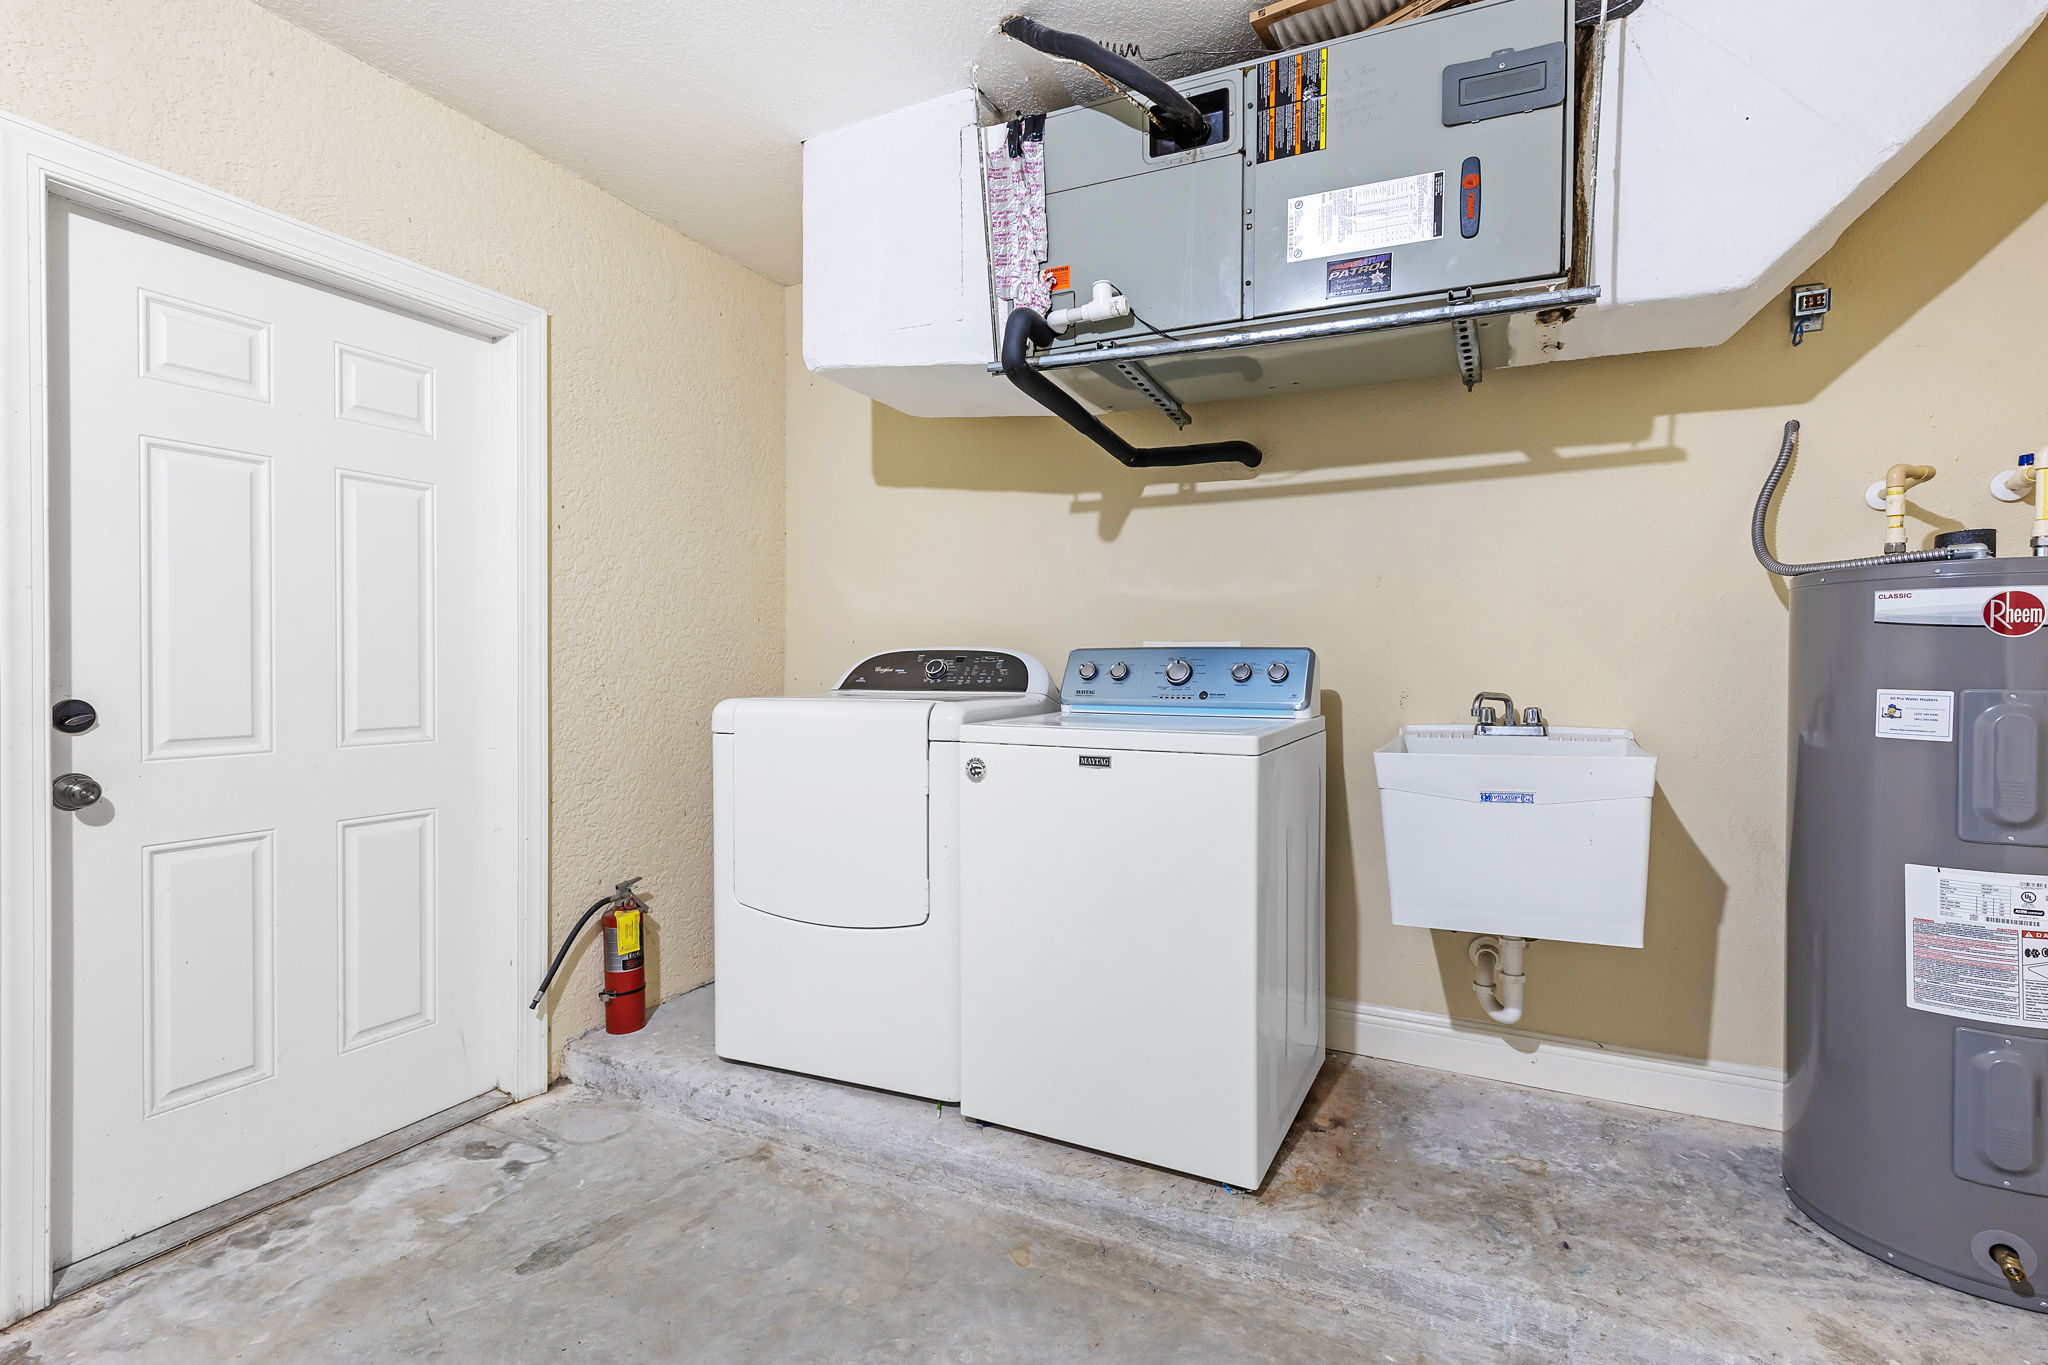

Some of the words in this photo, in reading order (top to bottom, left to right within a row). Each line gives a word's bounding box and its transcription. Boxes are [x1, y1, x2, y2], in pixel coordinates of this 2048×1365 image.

[1328, 261, 1388, 280] PATROL
[1878, 592, 1912, 600] CLASSIC
[1990, 591, 2043, 630] Rheem
[1080, 757, 1109, 766] MAYTAG
